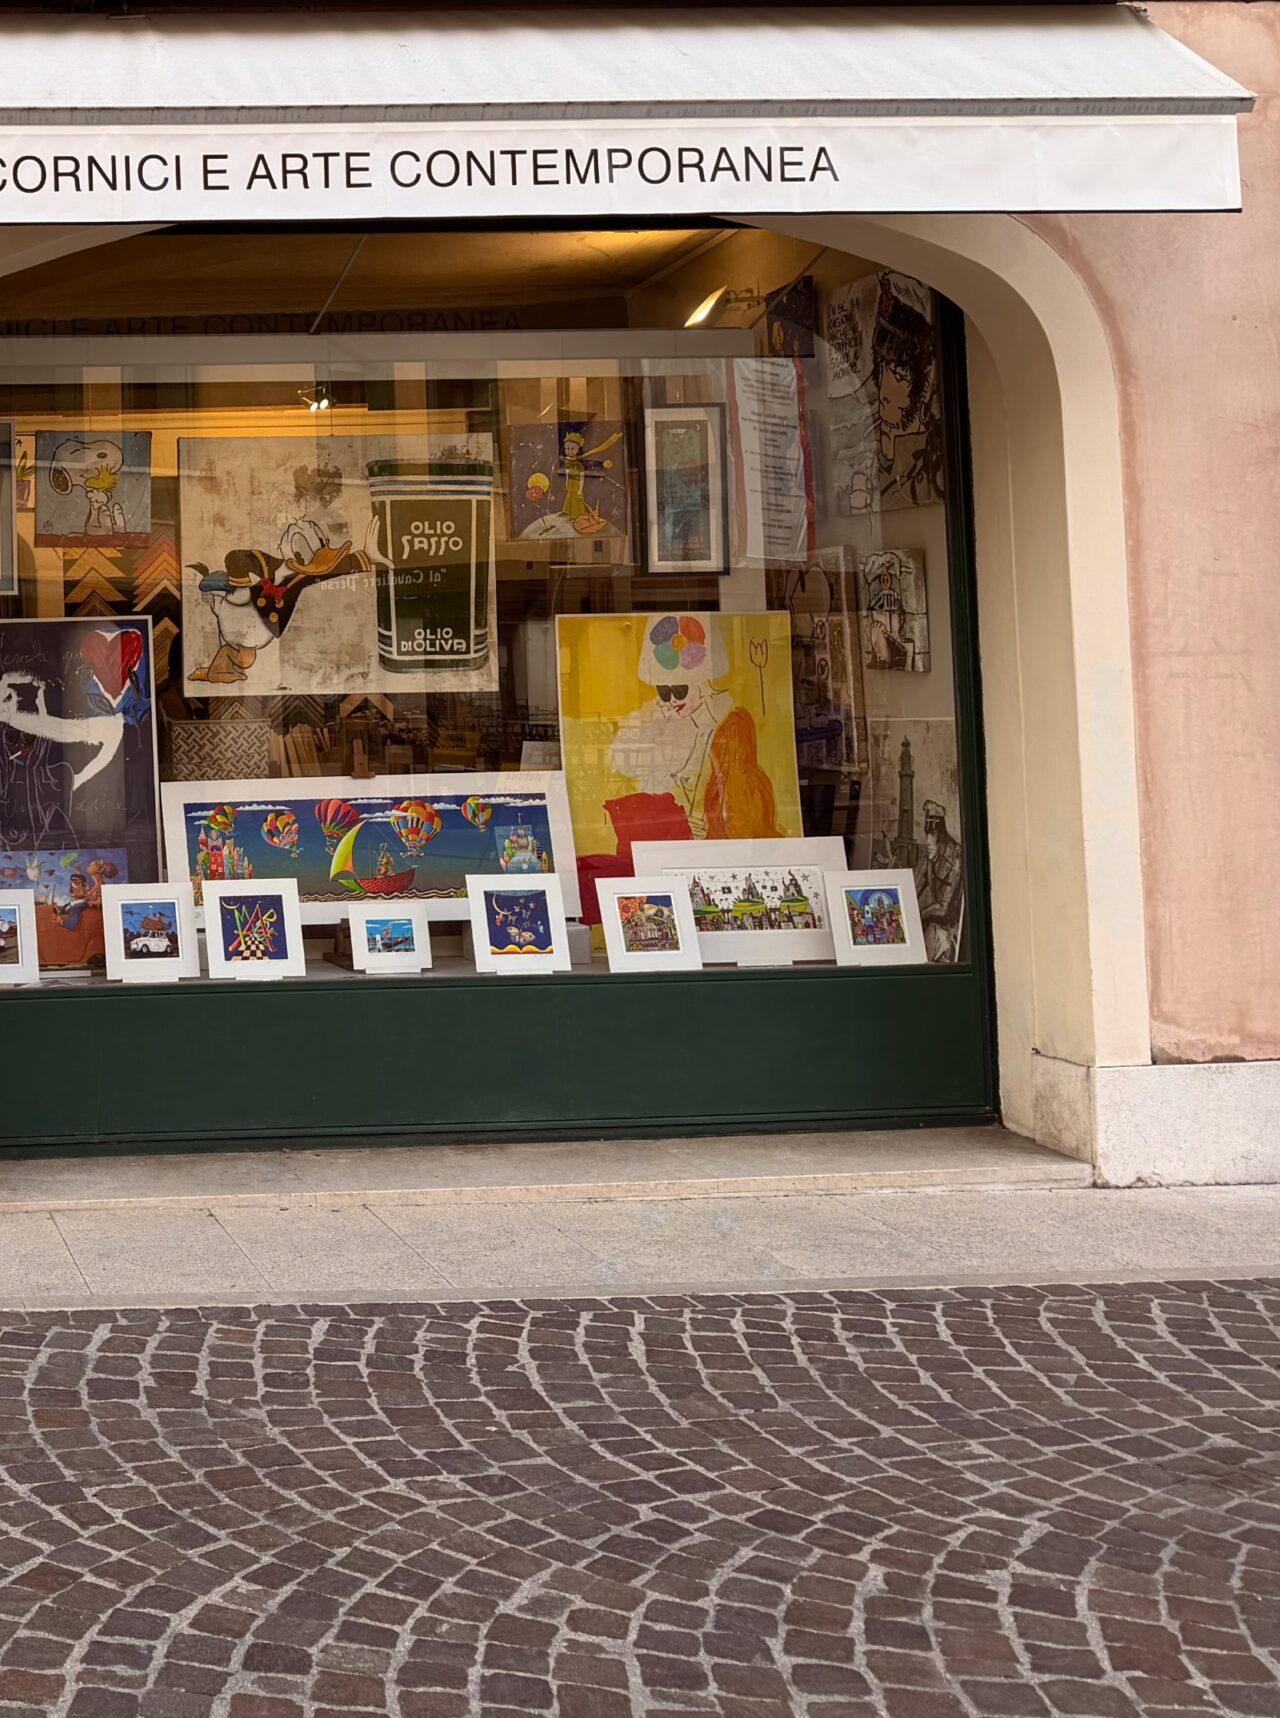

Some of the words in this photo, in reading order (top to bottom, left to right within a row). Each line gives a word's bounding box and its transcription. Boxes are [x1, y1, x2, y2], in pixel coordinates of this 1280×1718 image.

[202, 154, 229, 191] E
[247, 151, 372, 190] ARTE
[390, 146, 839, 188] CONTEMPORANEA
[410, 520, 456, 535] OLIO
[401, 535, 464, 560] SASSO
[414, 627, 453, 639] OLIO
[413, 639, 467, 652] OLIVA
